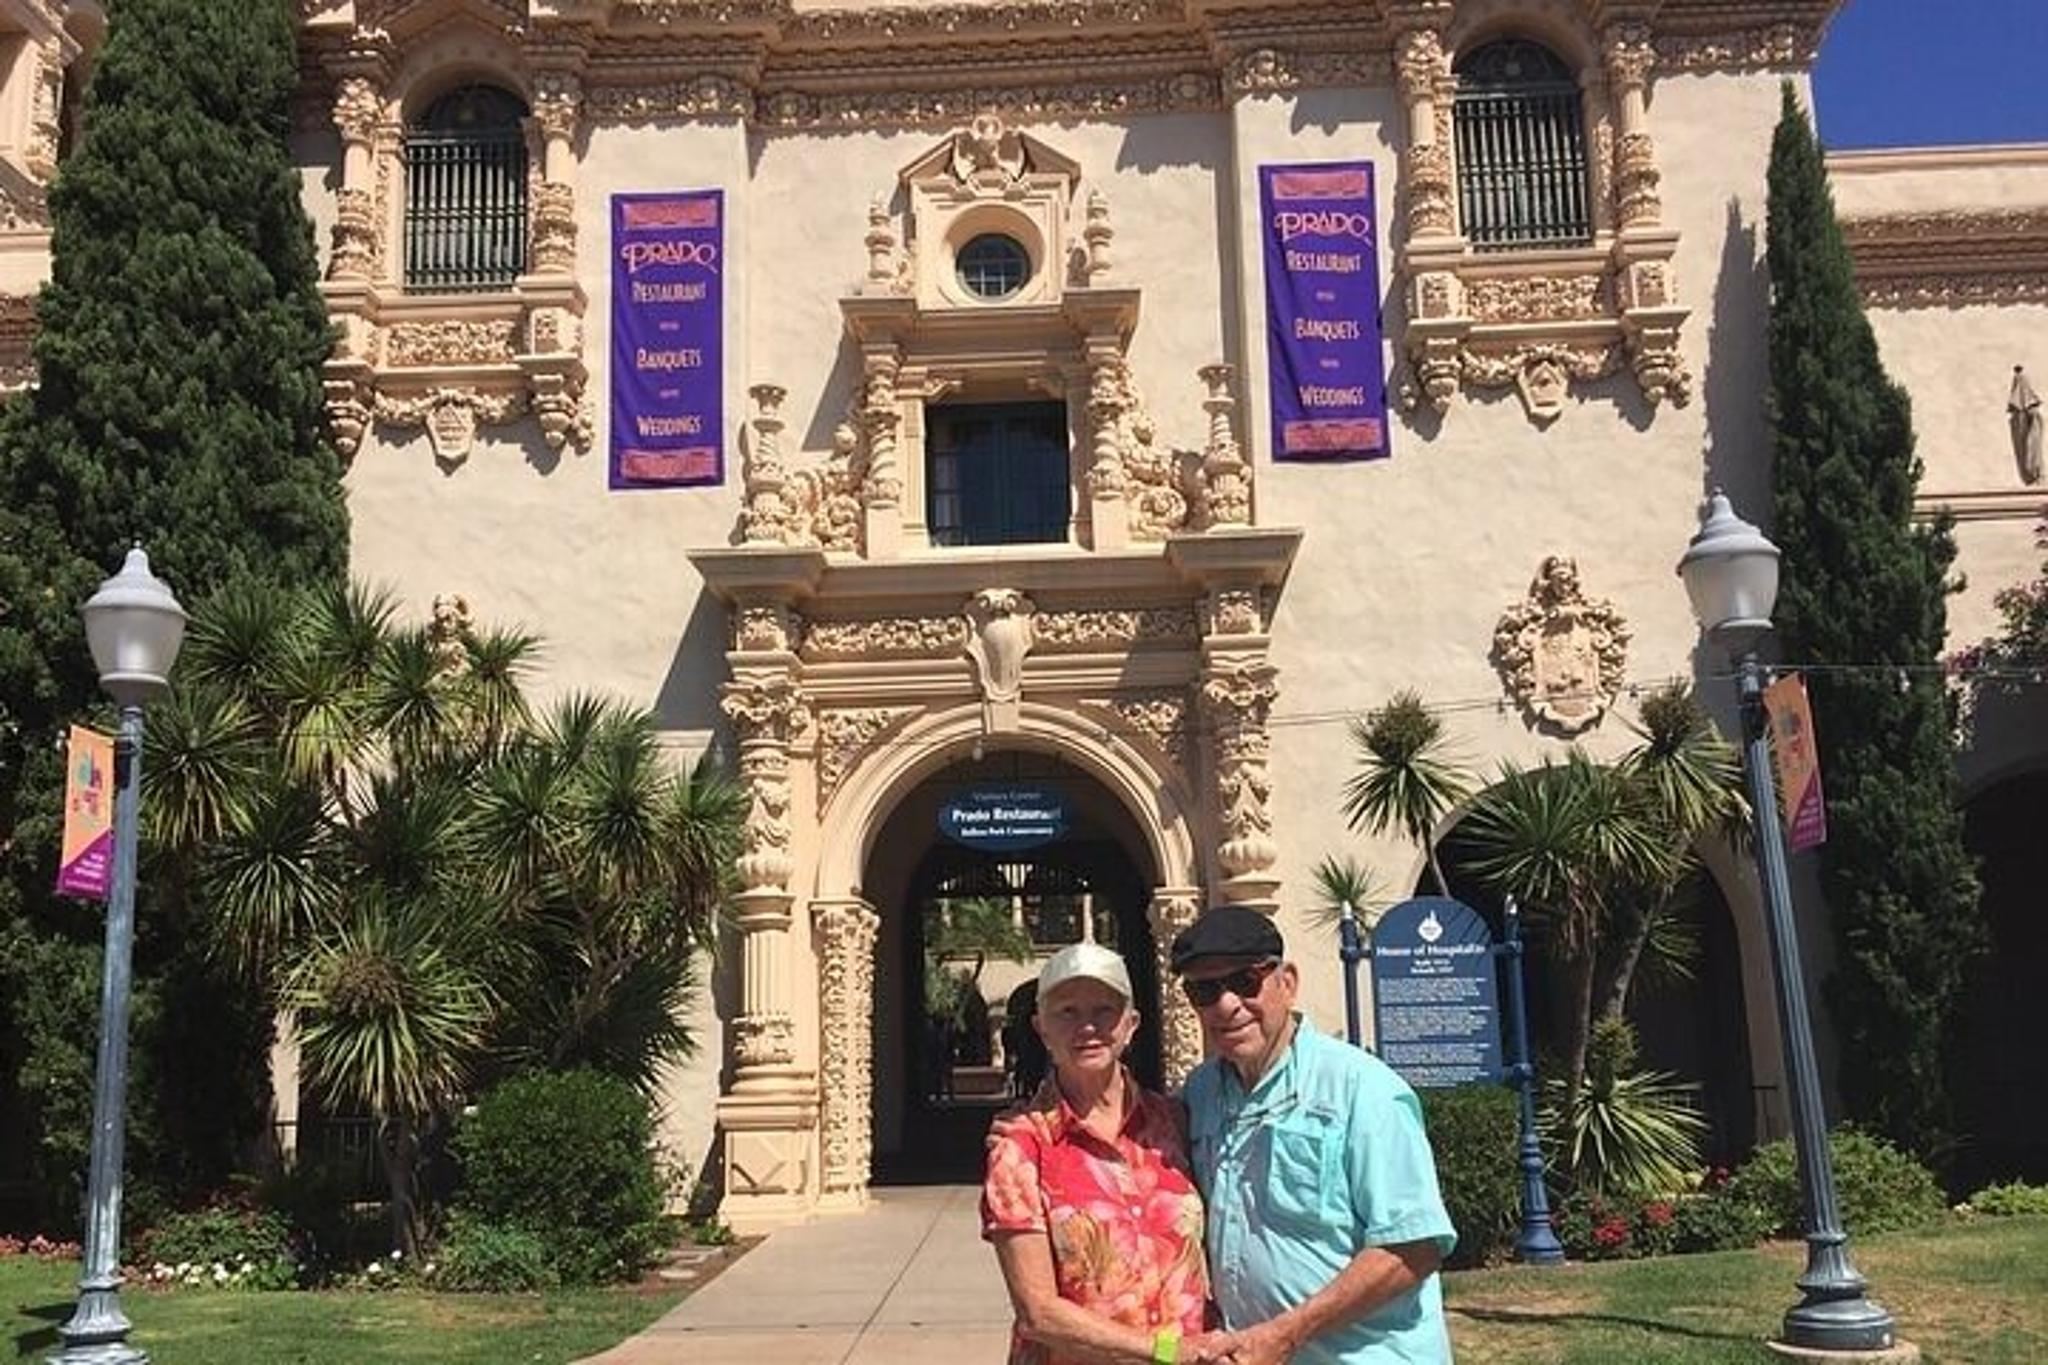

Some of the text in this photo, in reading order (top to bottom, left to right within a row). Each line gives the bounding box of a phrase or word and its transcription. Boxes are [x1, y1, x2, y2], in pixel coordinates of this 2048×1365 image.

[1274, 210, 1373, 248] PRADO
[621, 240, 719, 274] PRADO
[1295, 317, 1361, 342] BANQUETS
[636, 347, 702, 372] BANQUETS
[1299, 385, 1365, 407] WEDDINGS
[636, 414, 701, 436] WEDDINGS
[952, 808, 990, 822] Prado
